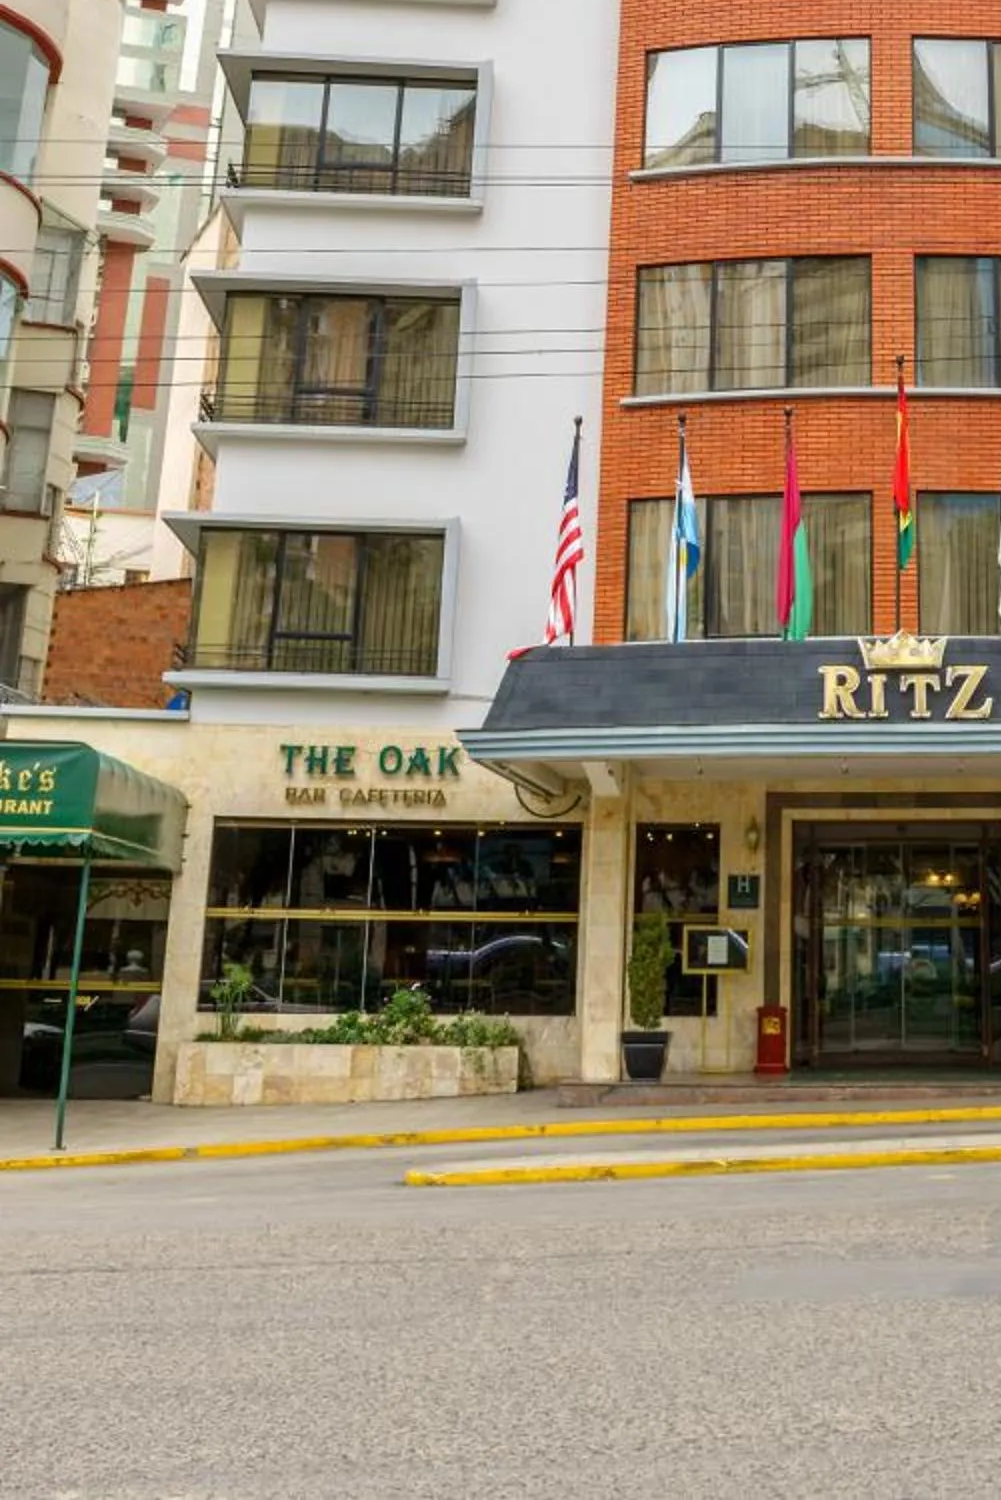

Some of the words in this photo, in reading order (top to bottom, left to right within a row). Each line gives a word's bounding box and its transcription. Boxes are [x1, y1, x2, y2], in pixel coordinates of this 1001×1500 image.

[818, 665, 993, 719] RITZ
[280, 744, 356, 775] THE
[379, 745, 460, 777] OAK
[285, 787, 326, 806] BAR
[339, 787, 447, 807] CAFETERIA
